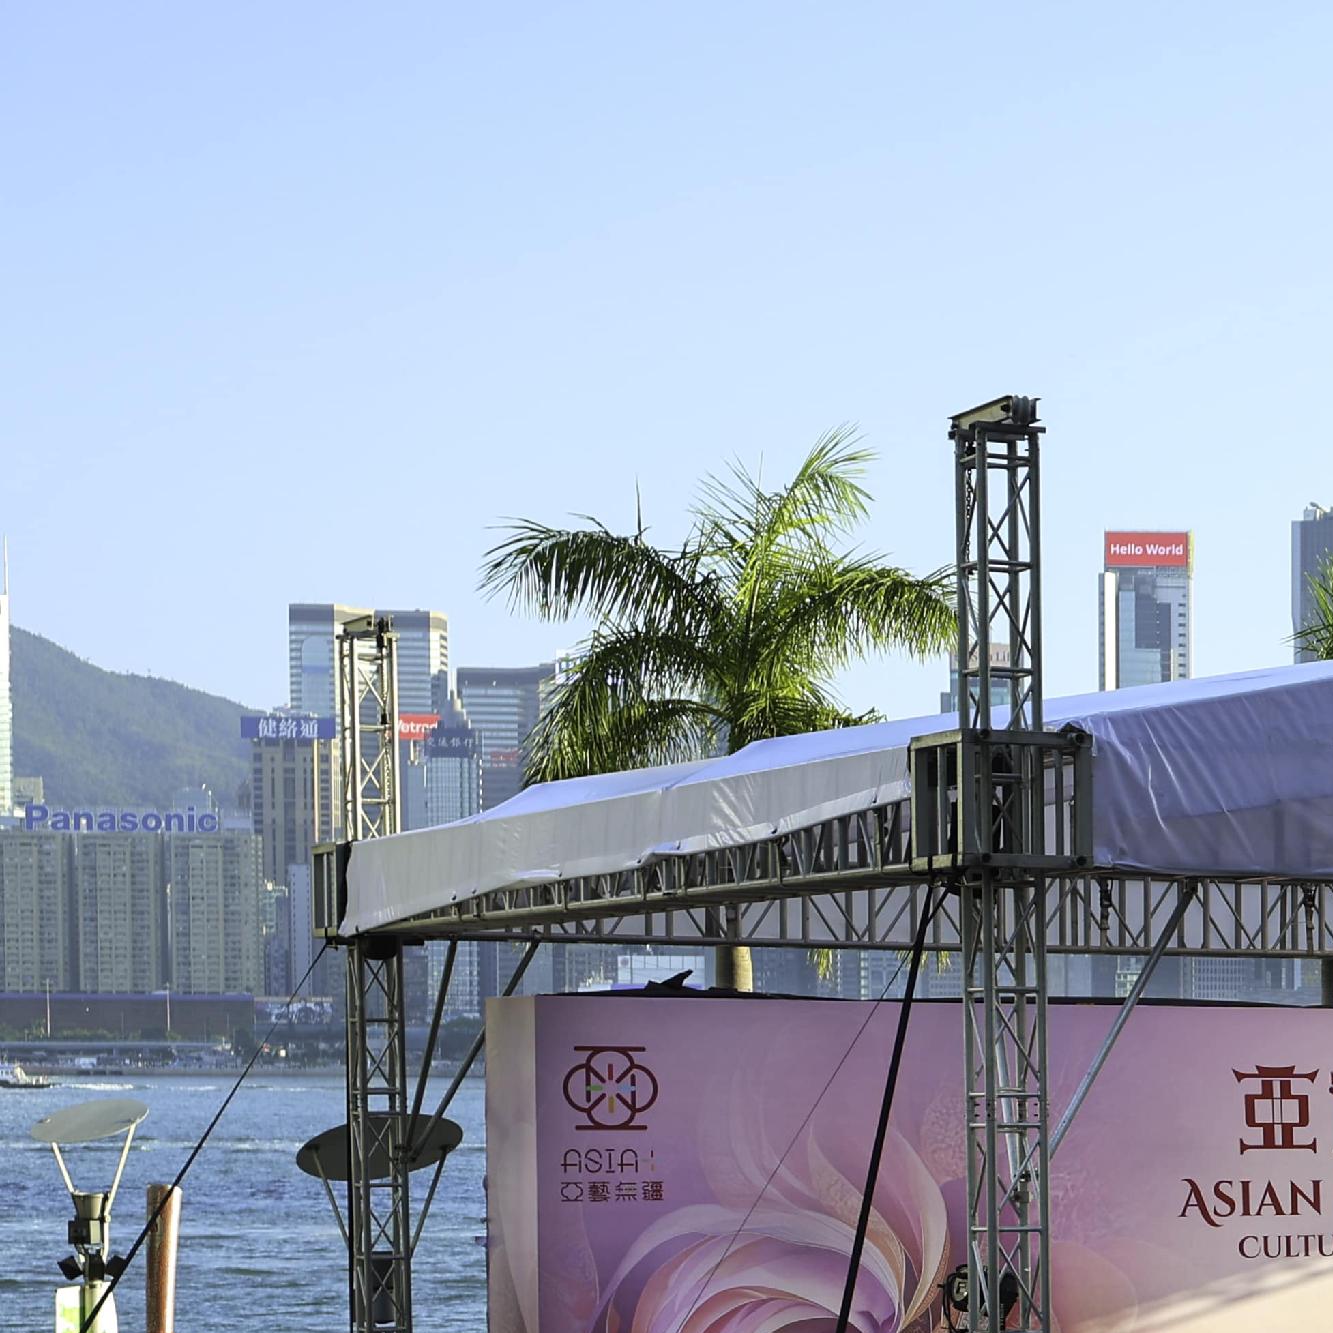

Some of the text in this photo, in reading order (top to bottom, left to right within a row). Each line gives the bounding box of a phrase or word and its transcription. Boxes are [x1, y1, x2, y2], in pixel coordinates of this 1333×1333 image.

[1110, 543, 1184, 555] Hello World
[25, 804, 218, 832] Panasonic
[1178, 1178, 1322, 1227] ASIAN
